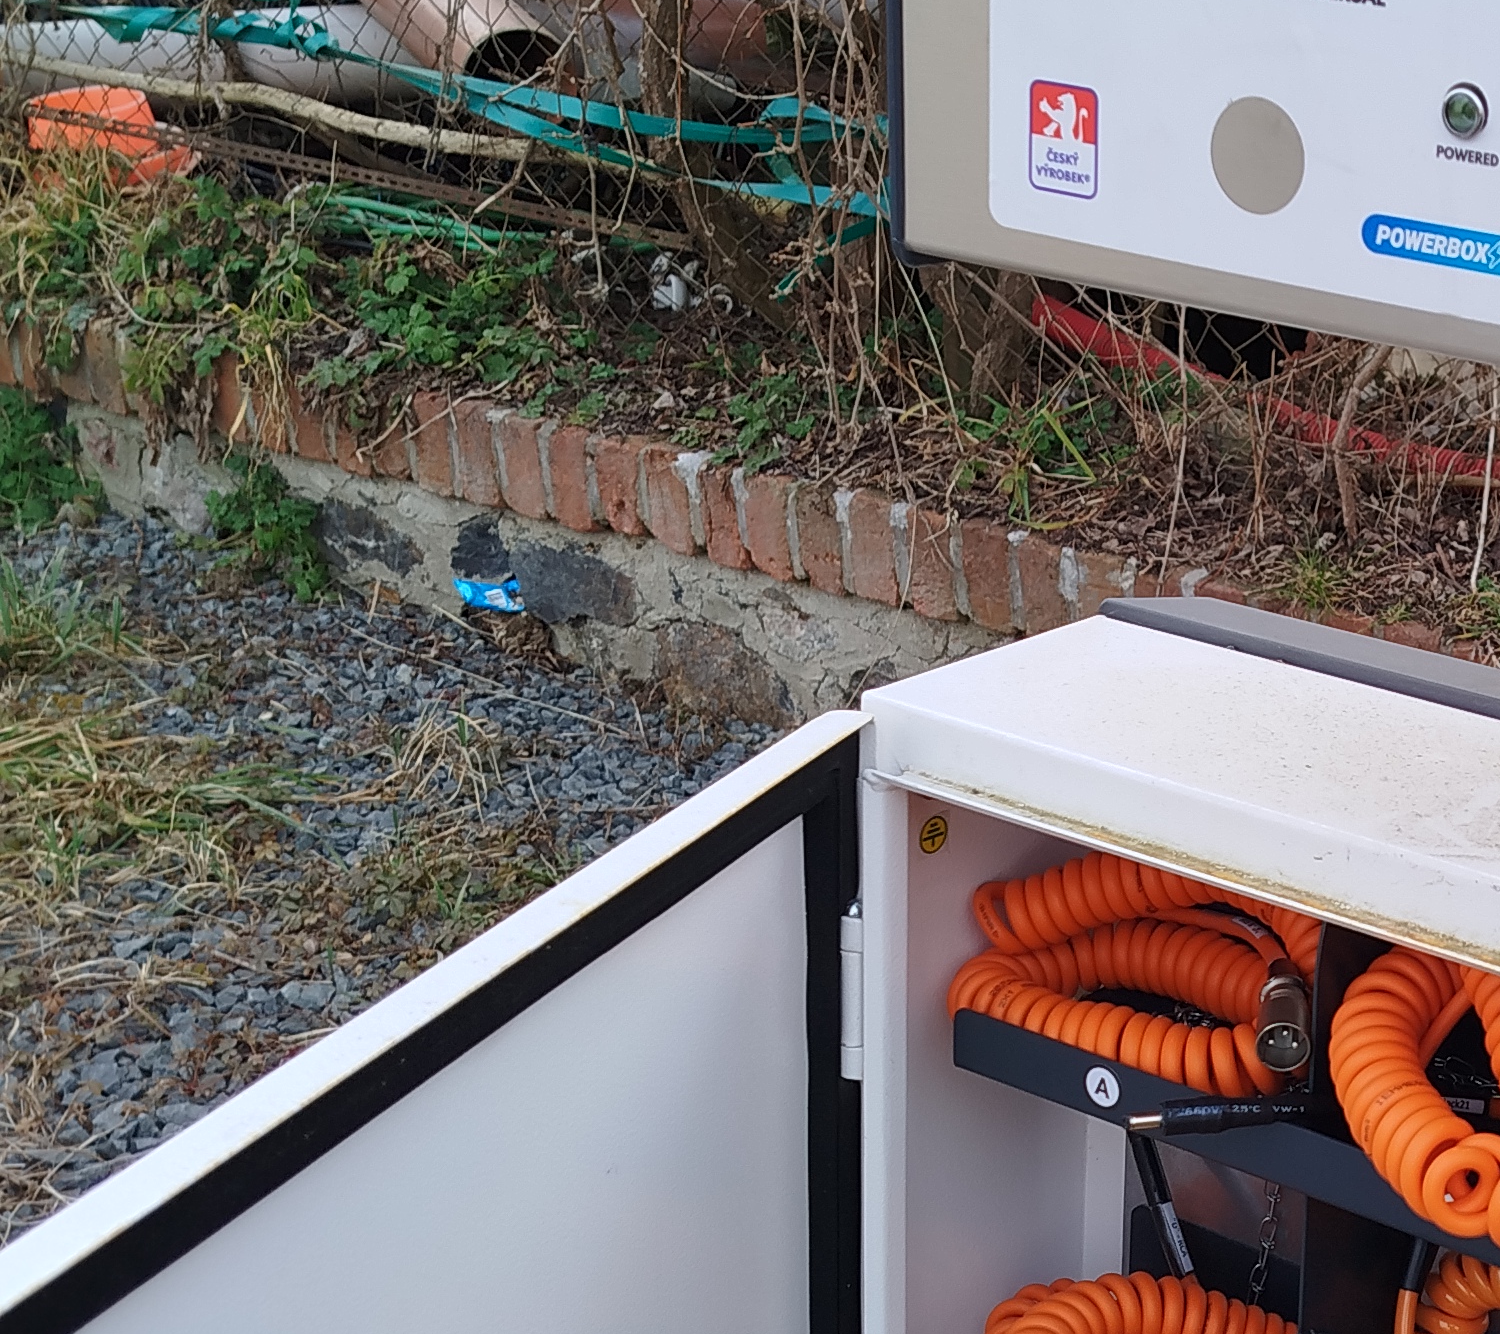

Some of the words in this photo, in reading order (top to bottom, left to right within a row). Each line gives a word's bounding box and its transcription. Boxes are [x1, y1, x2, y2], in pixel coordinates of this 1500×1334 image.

[1046, 146, 1079, 166] ČESKÝ
[1436, 144, 1500, 167] POWERED
[1375, 224, 1490, 264] POWERBOX
[1094, 1076, 1110, 1099] A
